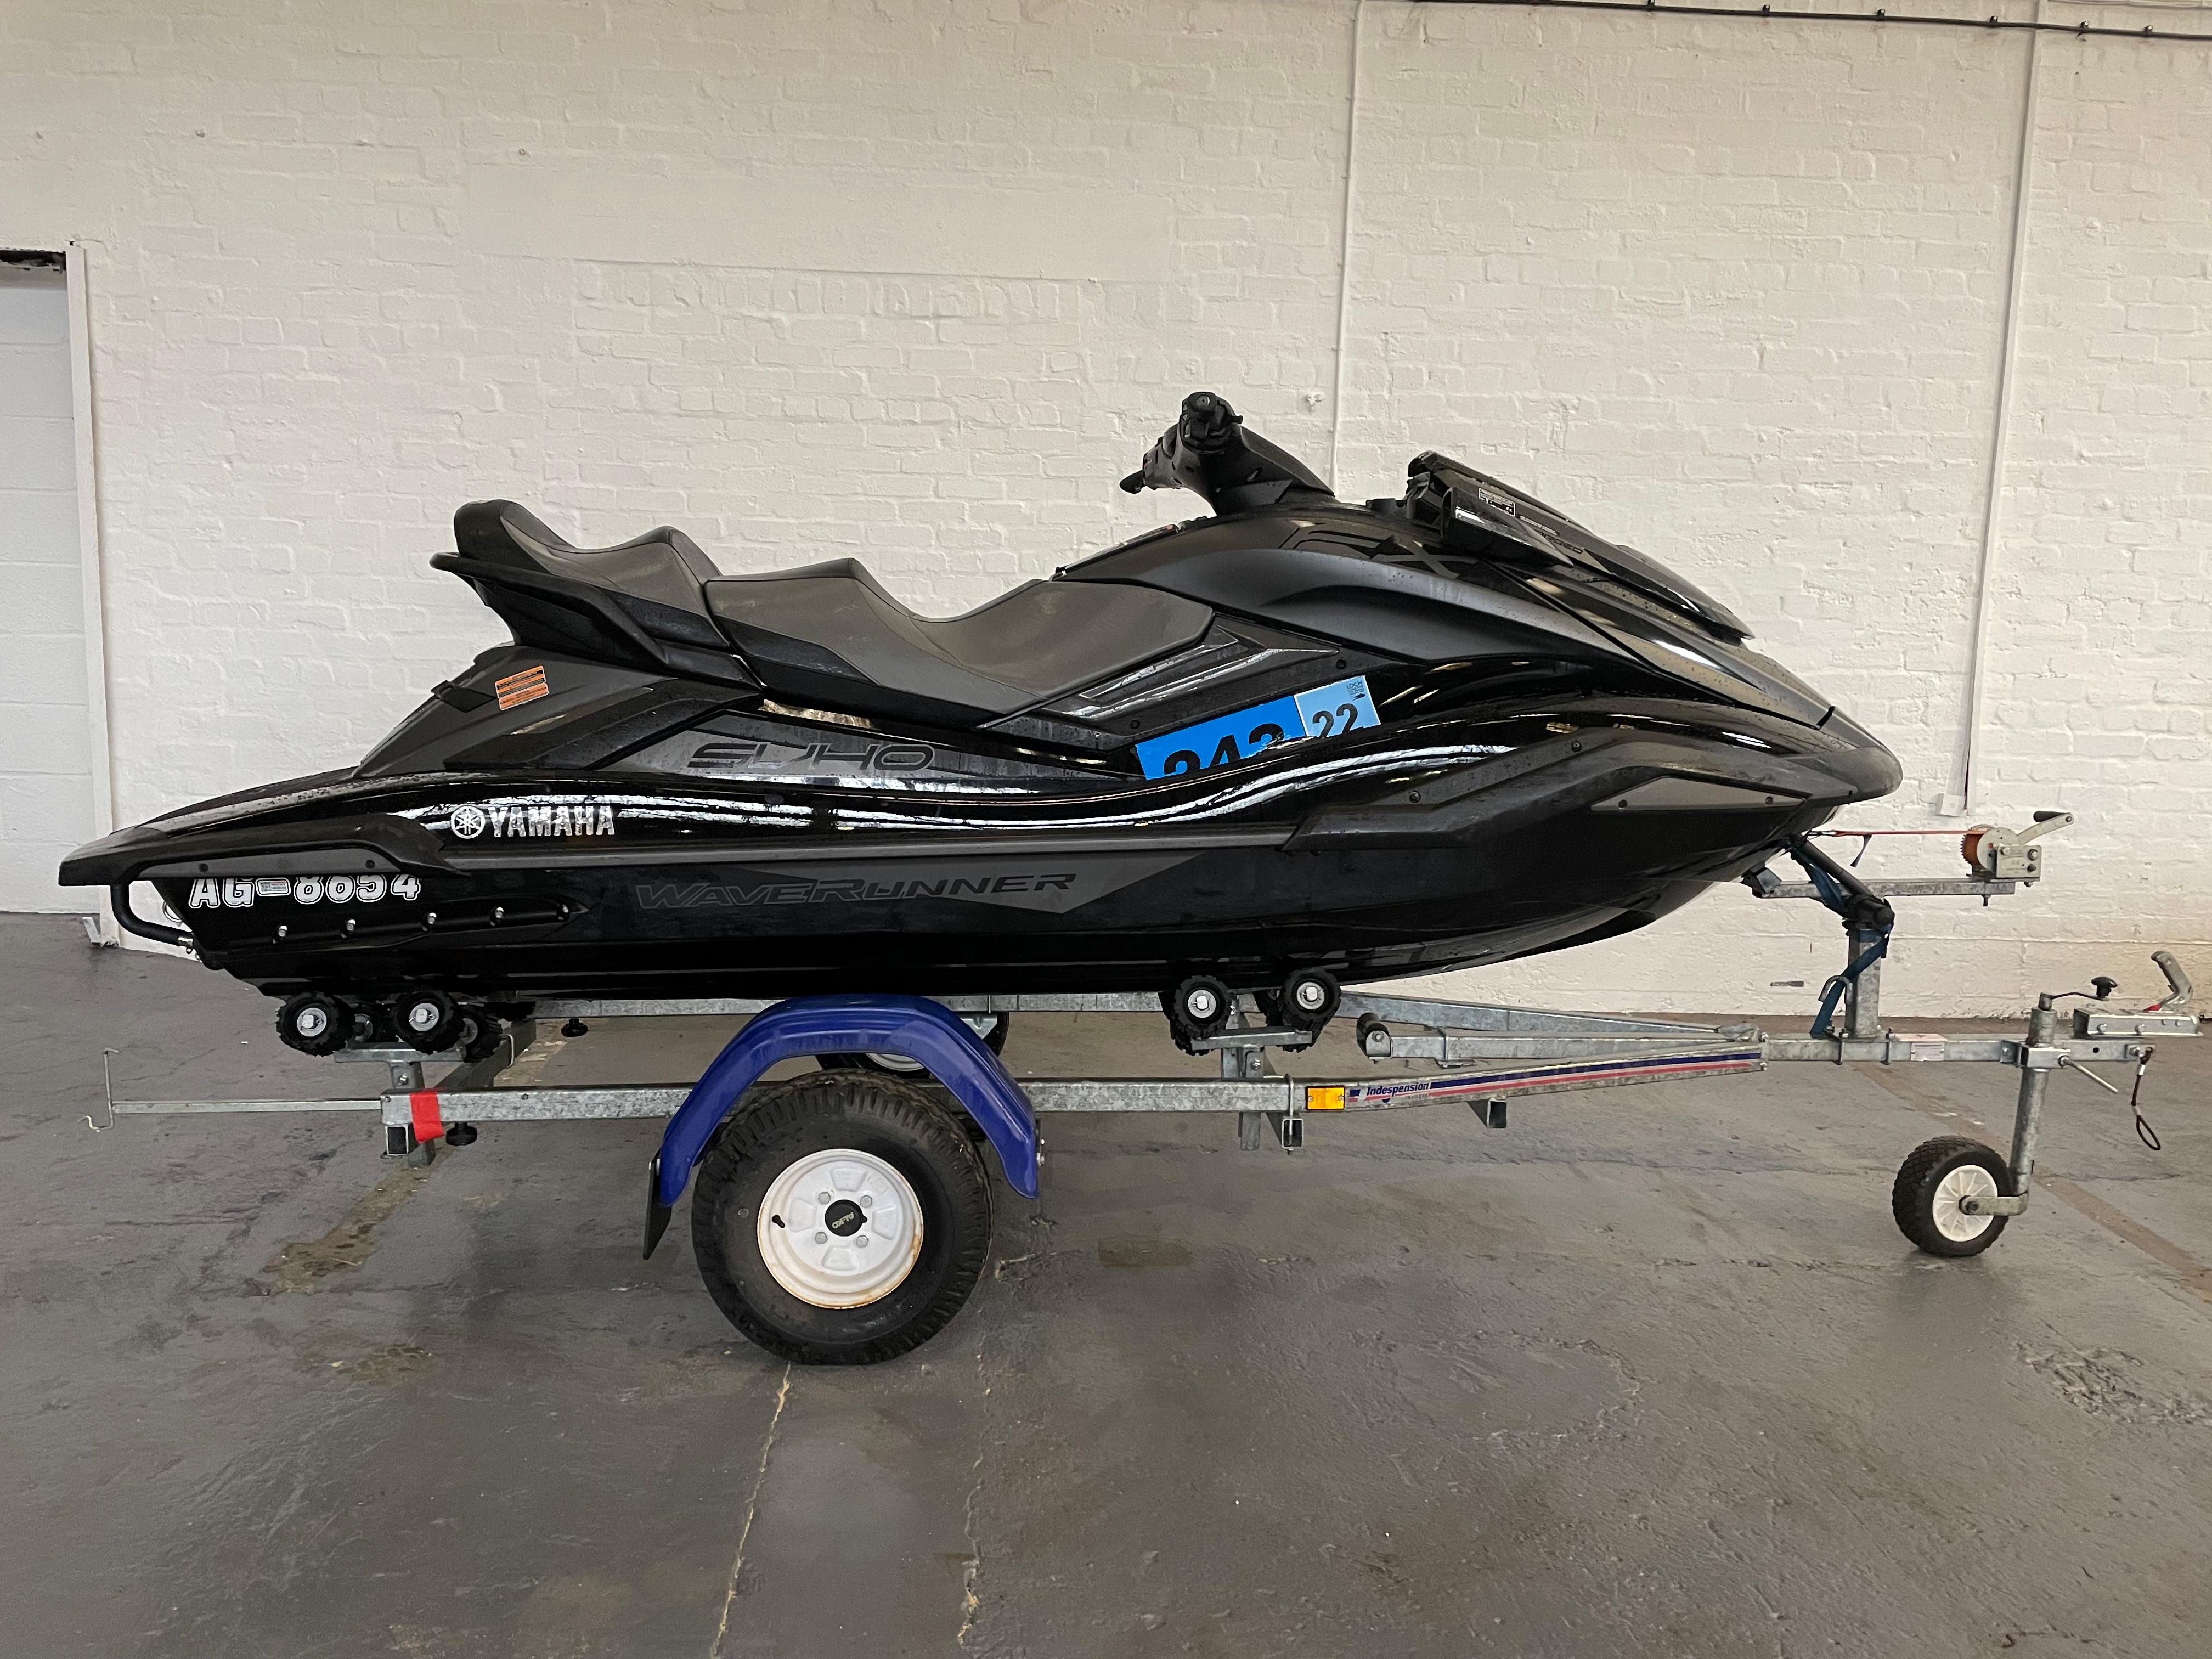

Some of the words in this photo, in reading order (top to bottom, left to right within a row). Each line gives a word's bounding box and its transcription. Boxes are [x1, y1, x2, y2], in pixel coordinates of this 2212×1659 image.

[1312, 703, 1364, 737] 22
[487, 806, 615, 837] YAMAHA
[1367, 1082, 1429, 1097] Indespension
